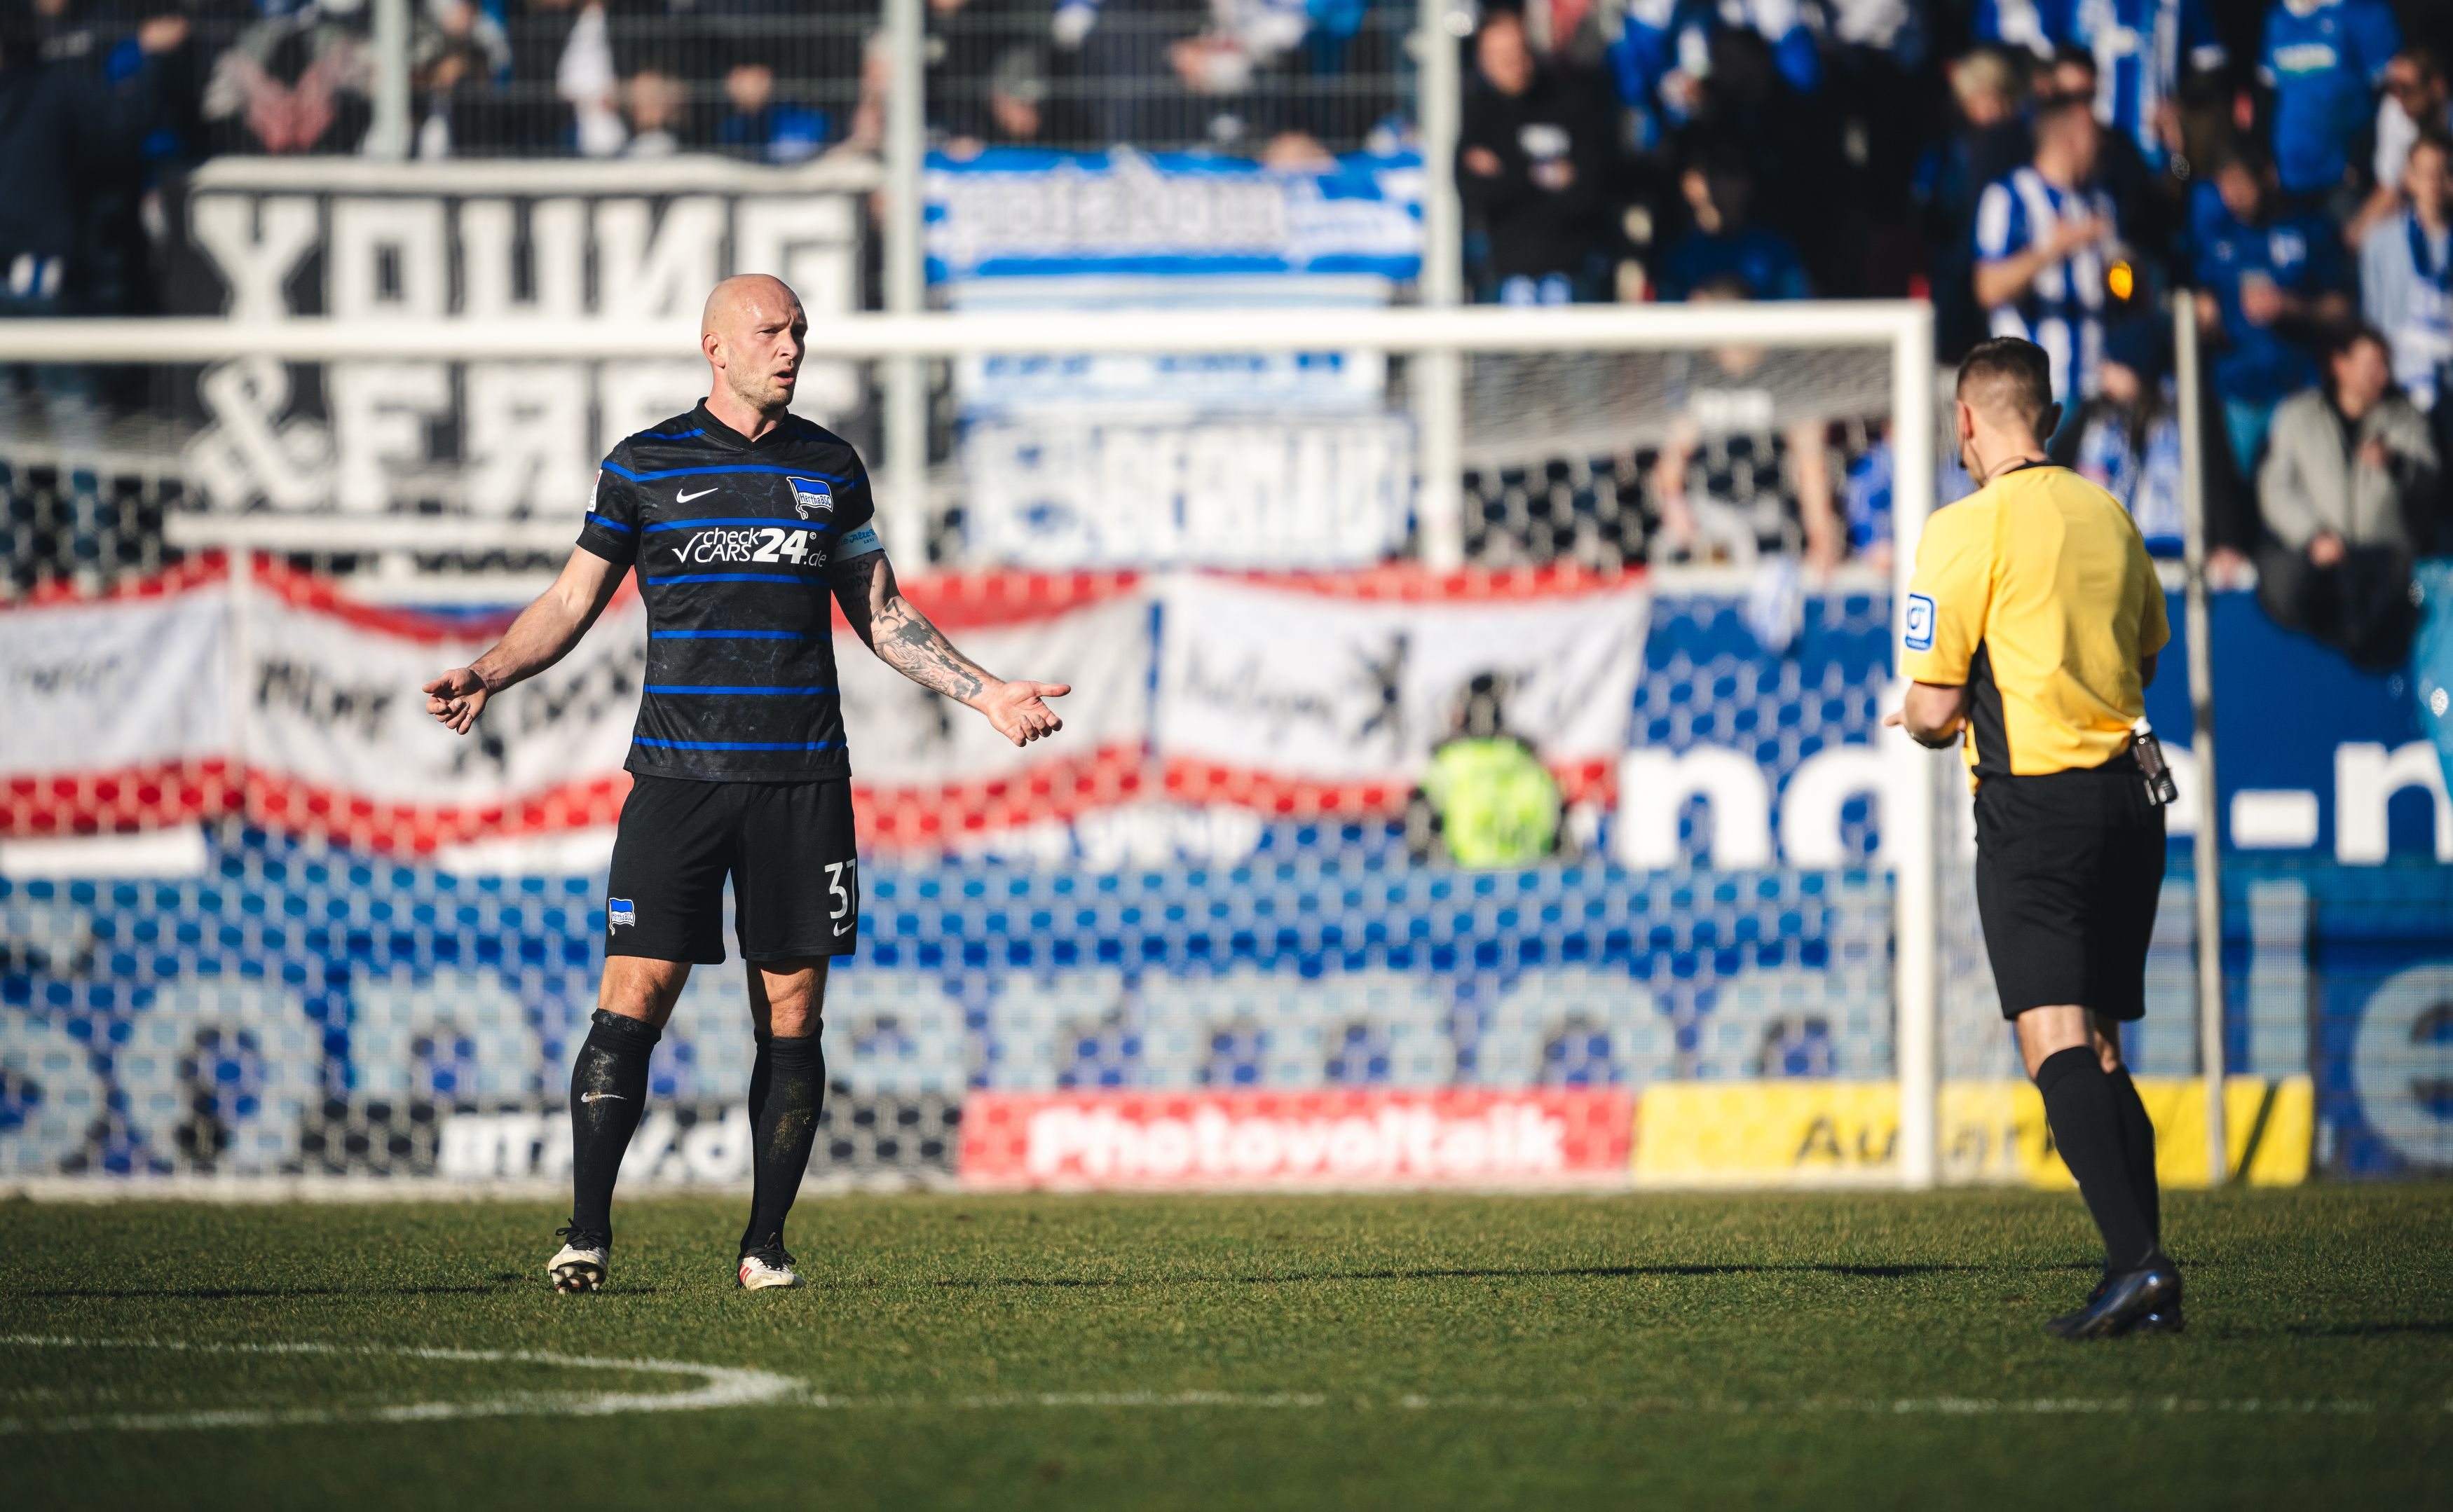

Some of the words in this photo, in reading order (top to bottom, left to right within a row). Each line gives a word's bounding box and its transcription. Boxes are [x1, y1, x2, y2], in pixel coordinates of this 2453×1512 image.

[694, 544, 752, 563] CARS
[752, 528, 809, 565] 24
[703, 527, 760, 546] check
[1025, 1104, 1566, 1173] Photovoltaik
